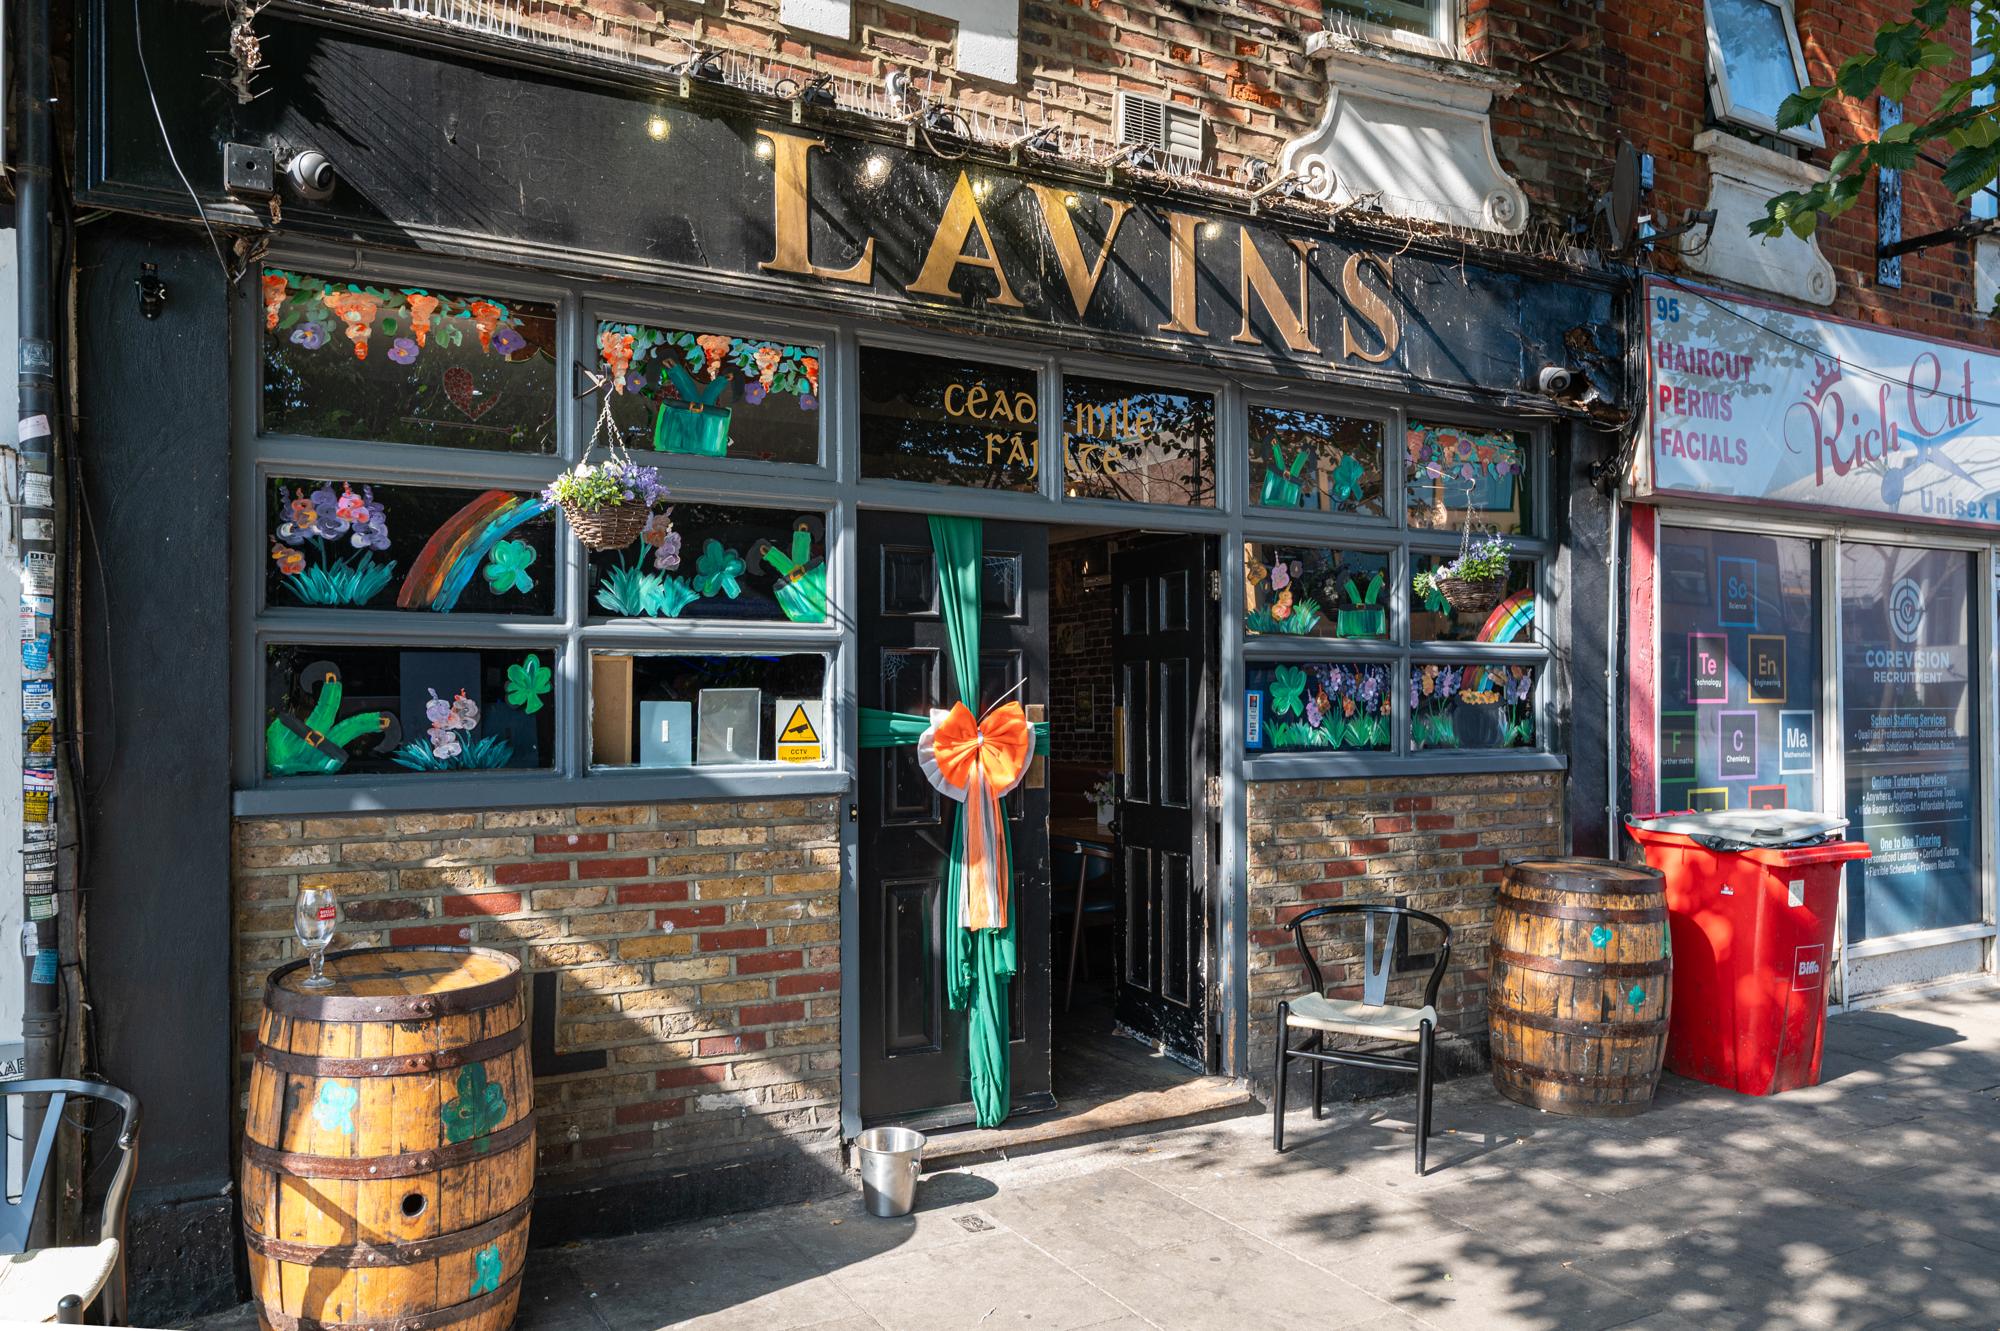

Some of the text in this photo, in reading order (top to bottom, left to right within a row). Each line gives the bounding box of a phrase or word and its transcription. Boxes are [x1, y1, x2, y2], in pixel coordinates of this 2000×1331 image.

[756, 128, 1400, 363] LAVINS
[1656, 296, 1680, 323] 95
[1658, 341, 1753, 384] HAIRCUT
[1659, 385, 1733, 421] PERMS
[1783, 352, 1978, 487] Rich Cut
[1660, 428, 1748, 466] FACIALS
[1920, 488, 1988, 519] Unisex
[1698, 652, 1717, 675] Te
[1758, 654, 1777, 675] En
[1865, 650, 1950, 669] COREVISION
[1694, 678, 1722, 688] Technology
[1754, 678, 1781, 688] Engineering
[1873, 671, 1943, 684] RECRUITMENT
[1870, 713, 1947, 728] School Staffing Services
[1733, 729, 1744, 752] C
[1786, 727, 1808, 749] Ma
[1726, 754, 1751, 764] Chemistry
[1783, 751, 1811, 759] Mathematics
[1871, 773, 1947, 789] Online Tutoring Services
[1880, 833, 1941, 849] One to One Tutoring
[1897, 850, 1919, 862] Learning
